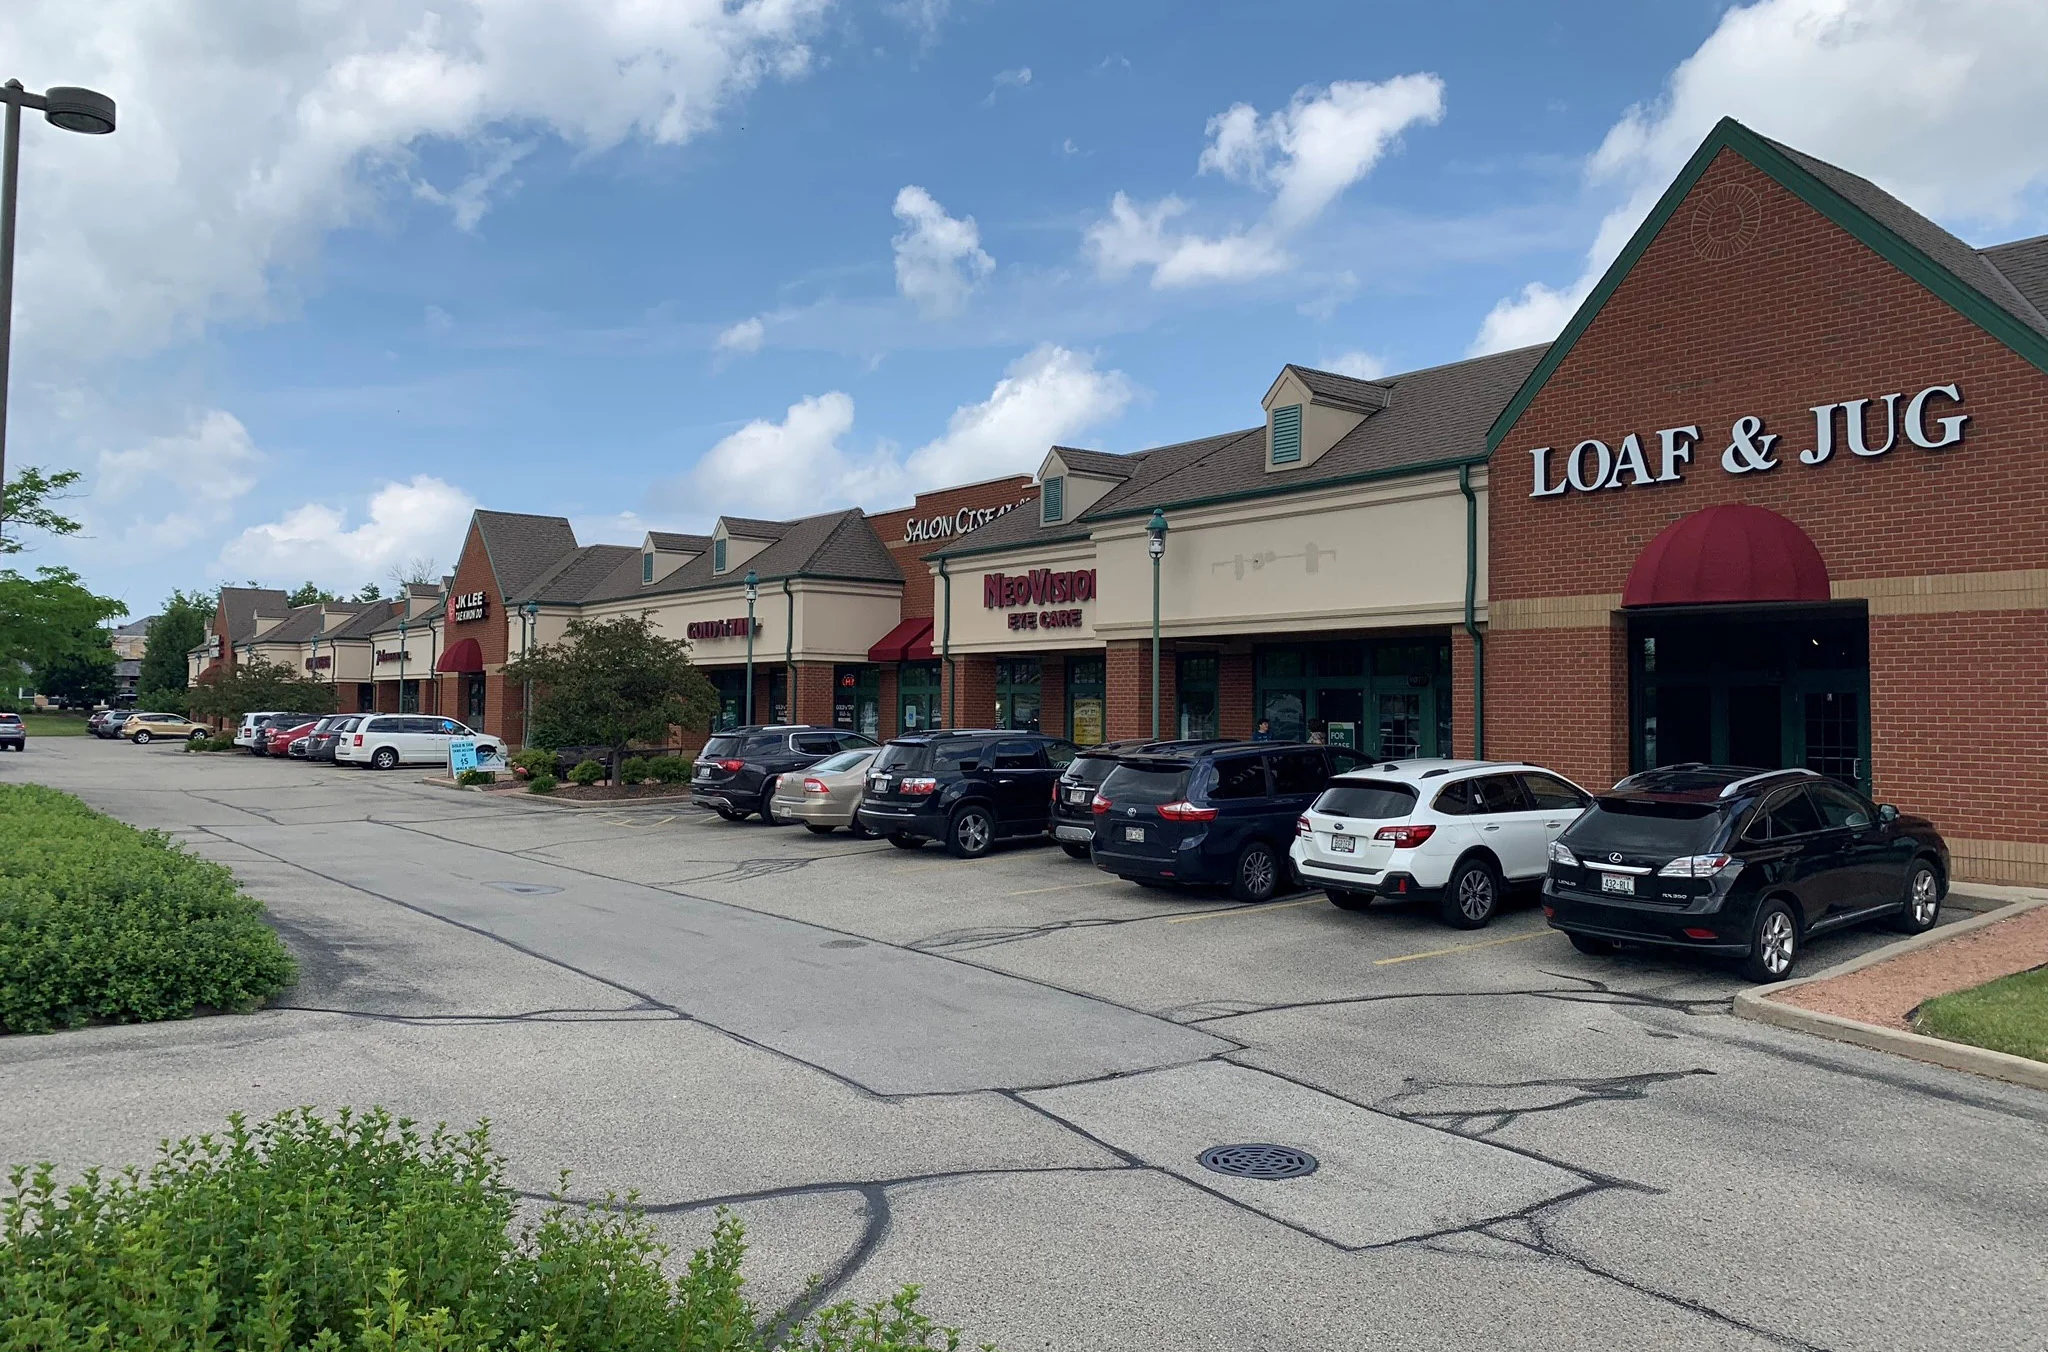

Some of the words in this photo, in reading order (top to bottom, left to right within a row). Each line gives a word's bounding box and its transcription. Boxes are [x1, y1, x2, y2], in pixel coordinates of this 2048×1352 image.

[1529, 424, 1699, 497] LOAF
[1721, 415, 1779, 474] &
[1800, 382, 1969, 465] JUG
[903, 516, 953, 542] SALON
[455, 594, 467, 609] JK
[467, 591, 483, 607] LEE
[1007, 612, 1038, 630] EYE
[1039, 609, 1083, 629] CARE
[687, 620, 719, 639] GOLD
[1330, 732, 1345, 740] FOR
[460, 757, 469, 766] $5
[1604, 878, 1632, 891] 432-RLL
